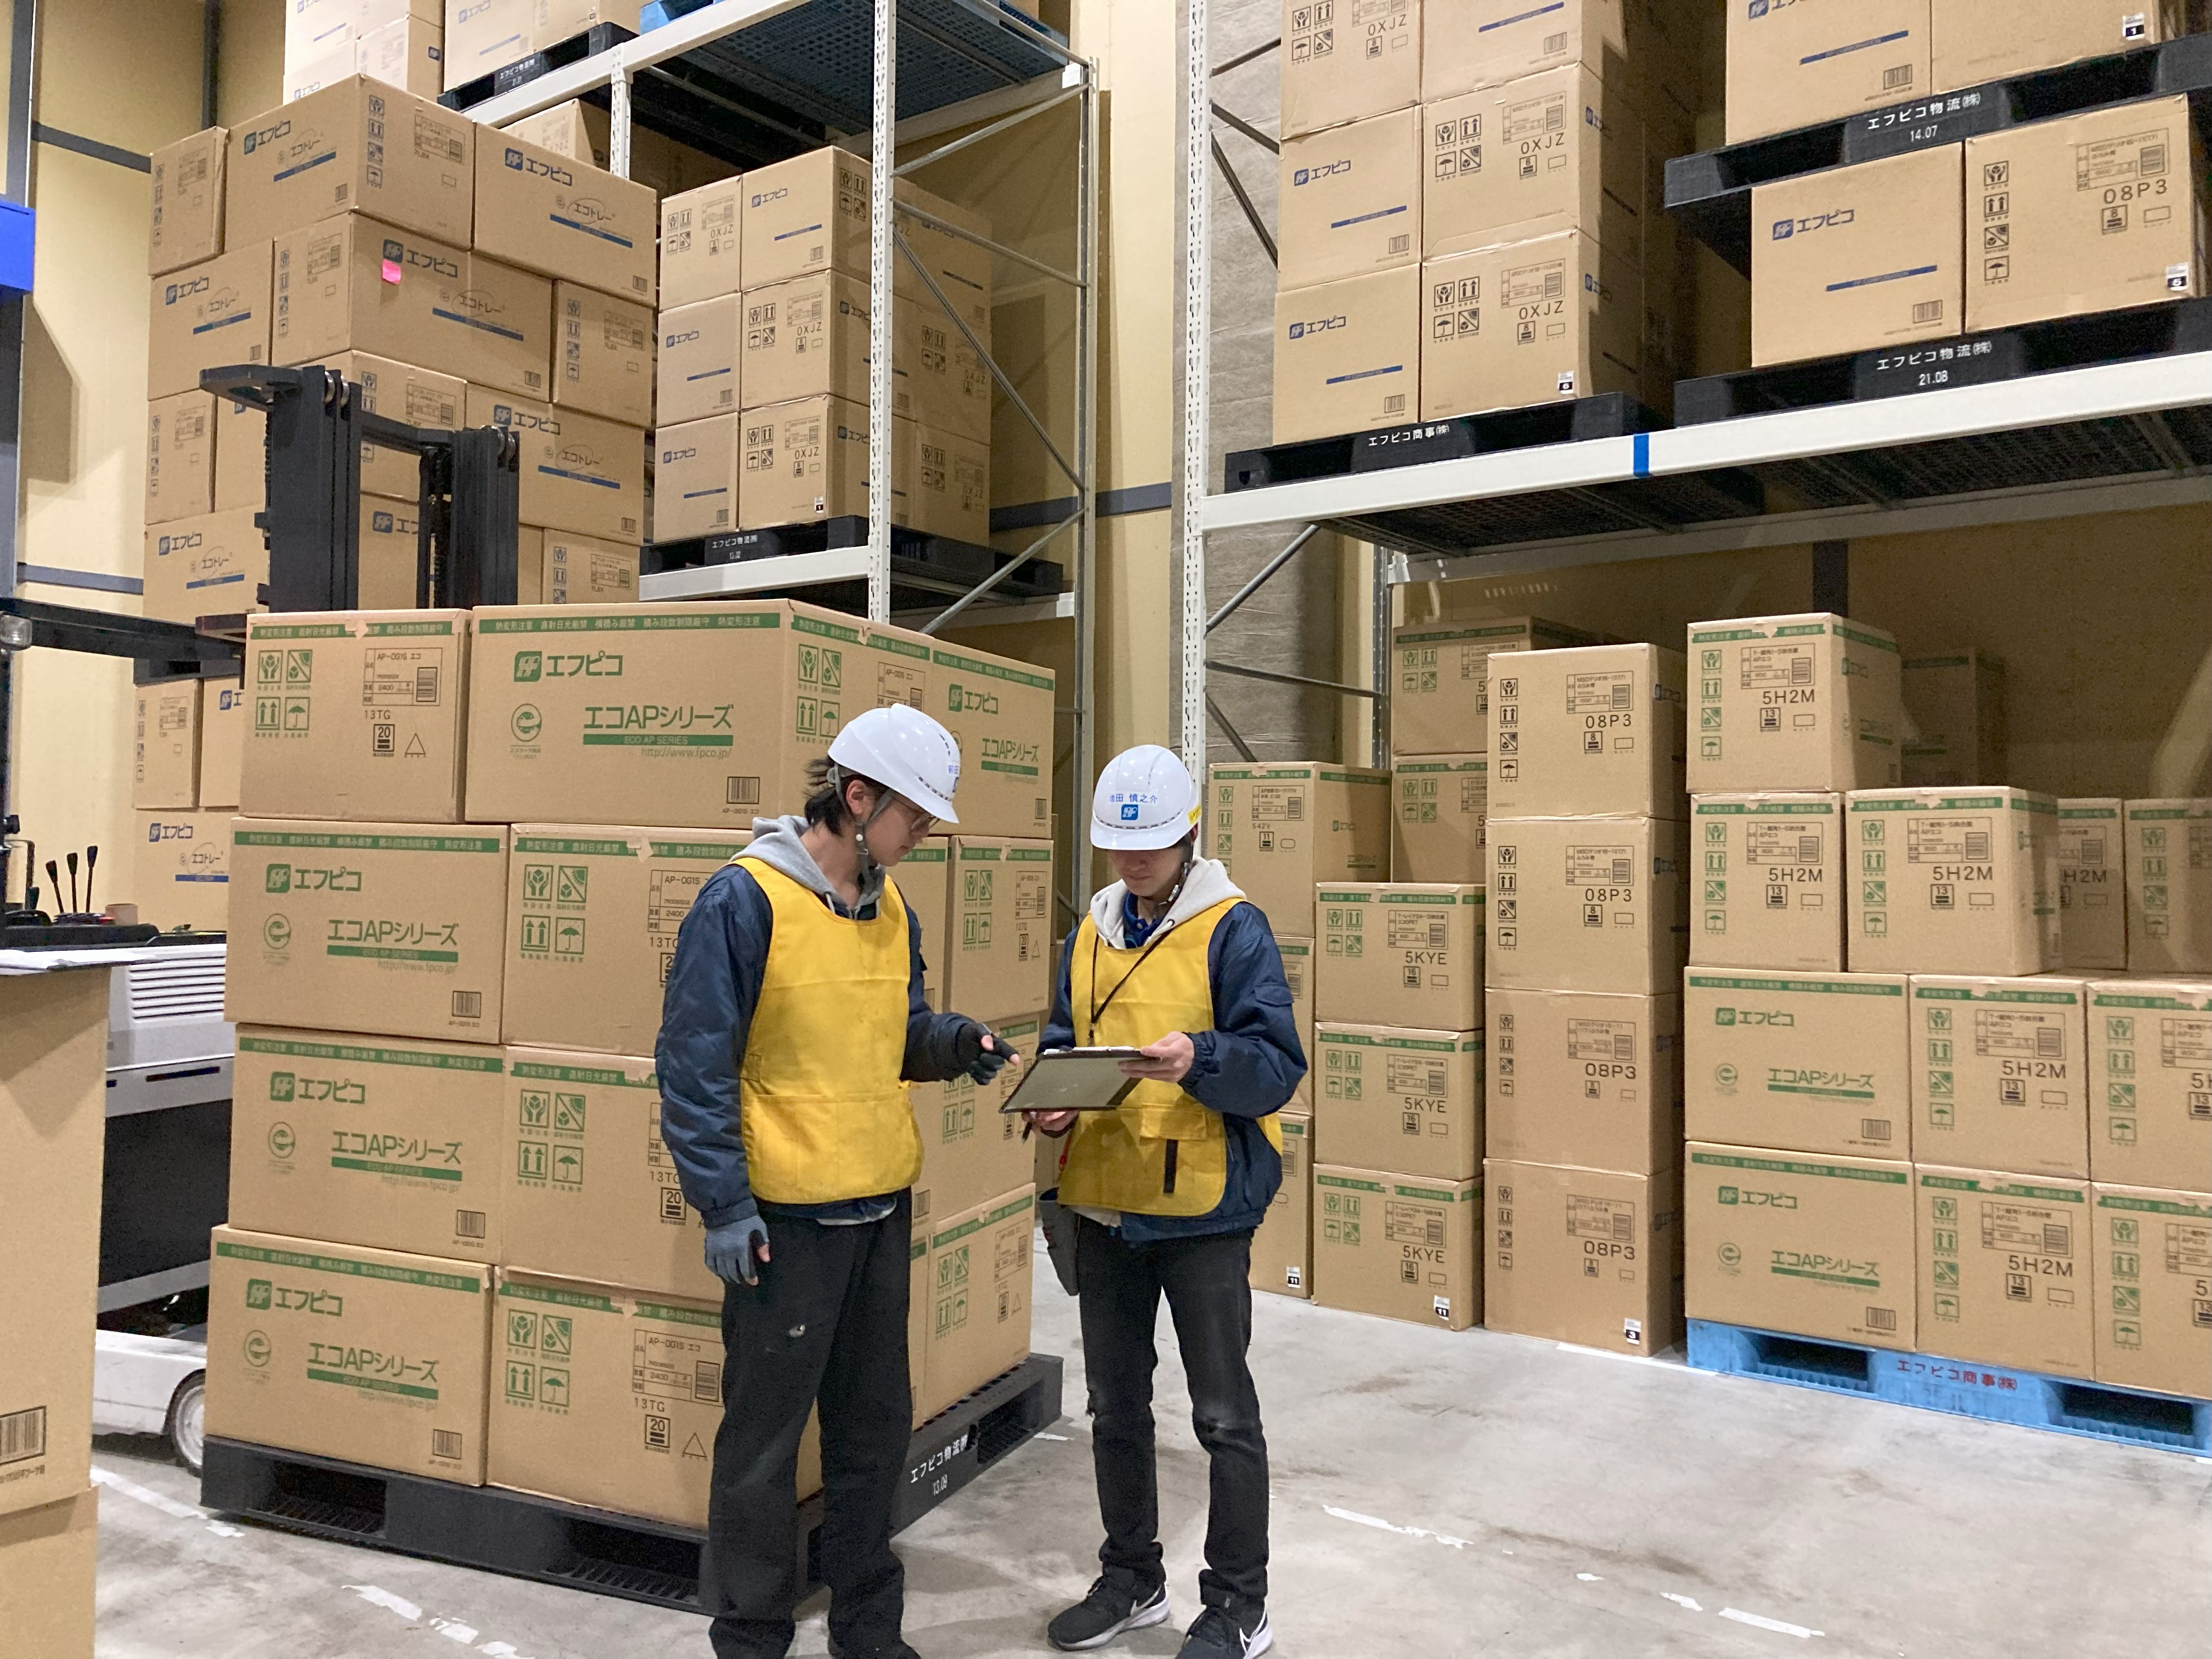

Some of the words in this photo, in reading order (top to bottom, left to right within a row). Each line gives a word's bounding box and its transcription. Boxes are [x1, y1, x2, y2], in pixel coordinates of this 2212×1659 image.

[257, 121, 291, 146] エフピコ
[1911, 125, 1938, 142] 14.07
[526, 159, 572, 186] エフピコ
[1311, 160, 1351, 180] エフピコ
[763, 188, 787, 204] エフピコ
[574, 201, 613, 221] エコトレー
[1797, 209, 1854, 234] エフピコ
[407, 250, 458, 279] エフピコ
[178, 276, 209, 297] エフピコ
[460, 294, 501, 314] エコトレー
[851, 306, 870, 320] エフピ
[1306, 316, 1346, 334] エフピコ
[676, 331, 699, 345] エフピコ
[515, 413, 561, 435] エフピコ
[561, 451, 600, 465] エコトレー
[673, 448, 696, 460] エフピコ
[172, 532, 202, 550] エフピコ
[546, 650, 623, 676] エフピコ
[965, 691, 998, 714] エフピコ
[1762, 689, 1815, 705] 5H2M
[364, 710, 390, 720] 13TG
[584, 704, 733, 729] エコAPシリーズ
[1585, 714, 1631, 729] 08P3
[1765, 709, 1775, 718] 13
[378, 727, 391, 738] 20
[657, 736, 688, 744] SERIES
[642, 747, 732, 759] http://www.fpco.jp/
[982, 738, 1039, 763] エコAPシリーズ
[162, 825, 193, 839] エフピコ
[192, 853, 222, 865] エコトレー
[295, 866, 362, 891] エフピコ
[1769, 868, 1822, 882] 5H2M
[1933, 866, 1993, 881] 5H2M
[2063, 870, 2107, 883] H2M
[1585, 888, 1632, 902] 08P3
[1771, 887, 1782, 895] 13
[1936, 885, 1948, 895] 13
[328, 919, 459, 946] エコAPシリーズ
[1021, 935, 1027, 945] 20
[1405, 951, 1447, 964] 5KYE
[1739, 1011, 1795, 1027] エフピコ
[1585, 1063, 1636, 1080] 08P3
[2002, 1060, 2066, 1079] 5H2M
[1768, 1068, 1874, 1088] エコAPシリーズ
[2006, 1081, 2018, 1091] 13
[298, 1079, 365, 1104] エフピコ
[1404, 1097, 1446, 1113] 5KYE
[332, 1131, 462, 1164] エコAPシリーズ
[666, 1192, 681, 1204] 20
[1742, 1190, 1798, 1209] エフピコ
[1403, 1245, 1445, 1263] 5KYE
[1584, 1241, 1635, 1260] 08P3
[1406, 1262, 1414, 1271] 16
[1771, 1250, 1880, 1277] エコAPシリーズ
[2008, 1255, 2073, 1277] 5H2M
[2012, 1276, 2024, 1286] 13
[275, 1288, 343, 1317] エフピコ
[308, 1342, 439, 1383] エコAPシリーズ
[650, 1373, 669, 1382] 2400
[634, 1398, 665, 1412] 13TG
[650, 1420, 665, 1432] 20
